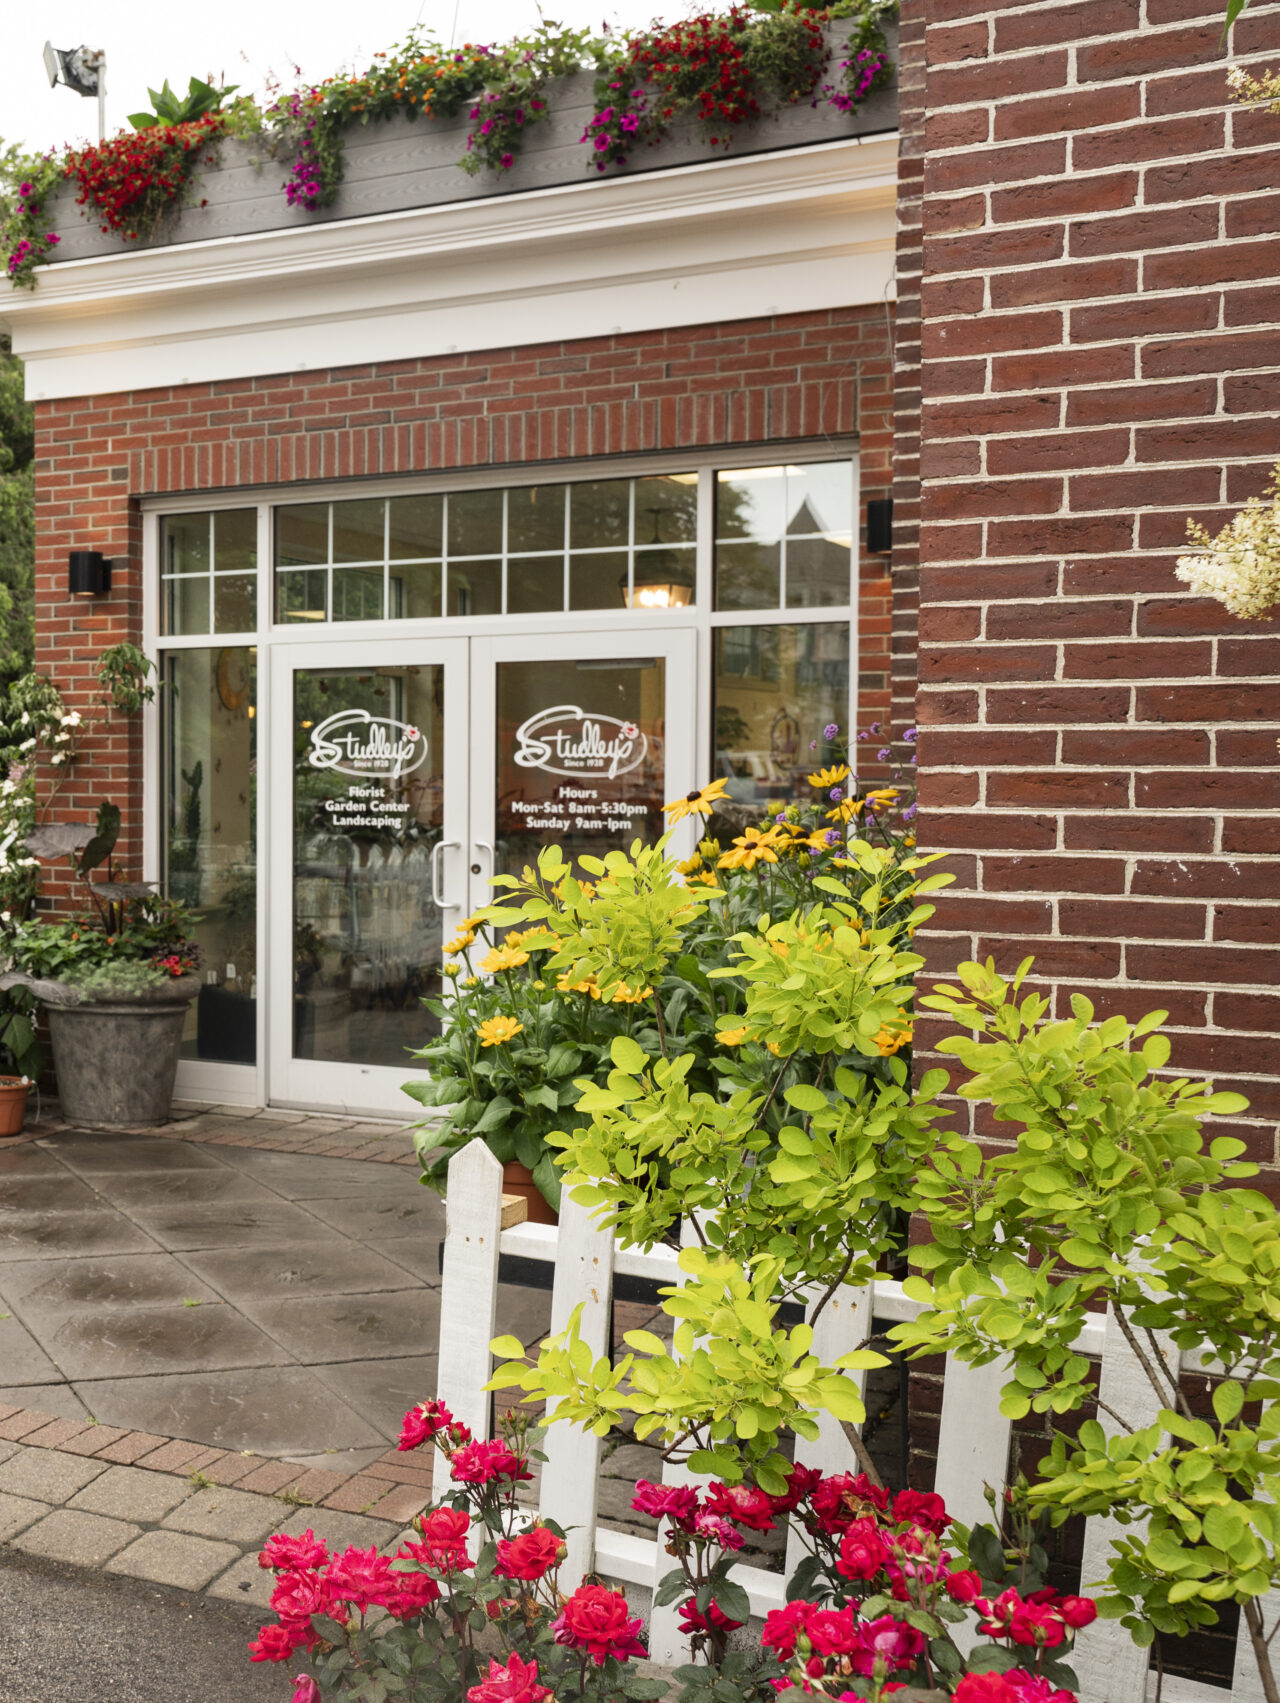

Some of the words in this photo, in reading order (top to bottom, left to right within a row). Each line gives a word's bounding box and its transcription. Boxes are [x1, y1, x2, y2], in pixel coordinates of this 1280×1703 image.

[309, 709, 417, 779] Studley's
[514, 705, 633, 779] Studley's
[348, 786, 385, 798] Florist
[559, 787, 598, 799] Hours
[325, 801, 366, 812] Garden
[370, 801, 410, 812] Center
[511, 802, 564, 814] Mon-Sat
[568, 802, 648, 816] 8am-5:30pm
[332, 815, 402, 829] Landscaping
[526, 816, 571, 832] Sunday
[575, 818, 632, 832] 9am-1pm
